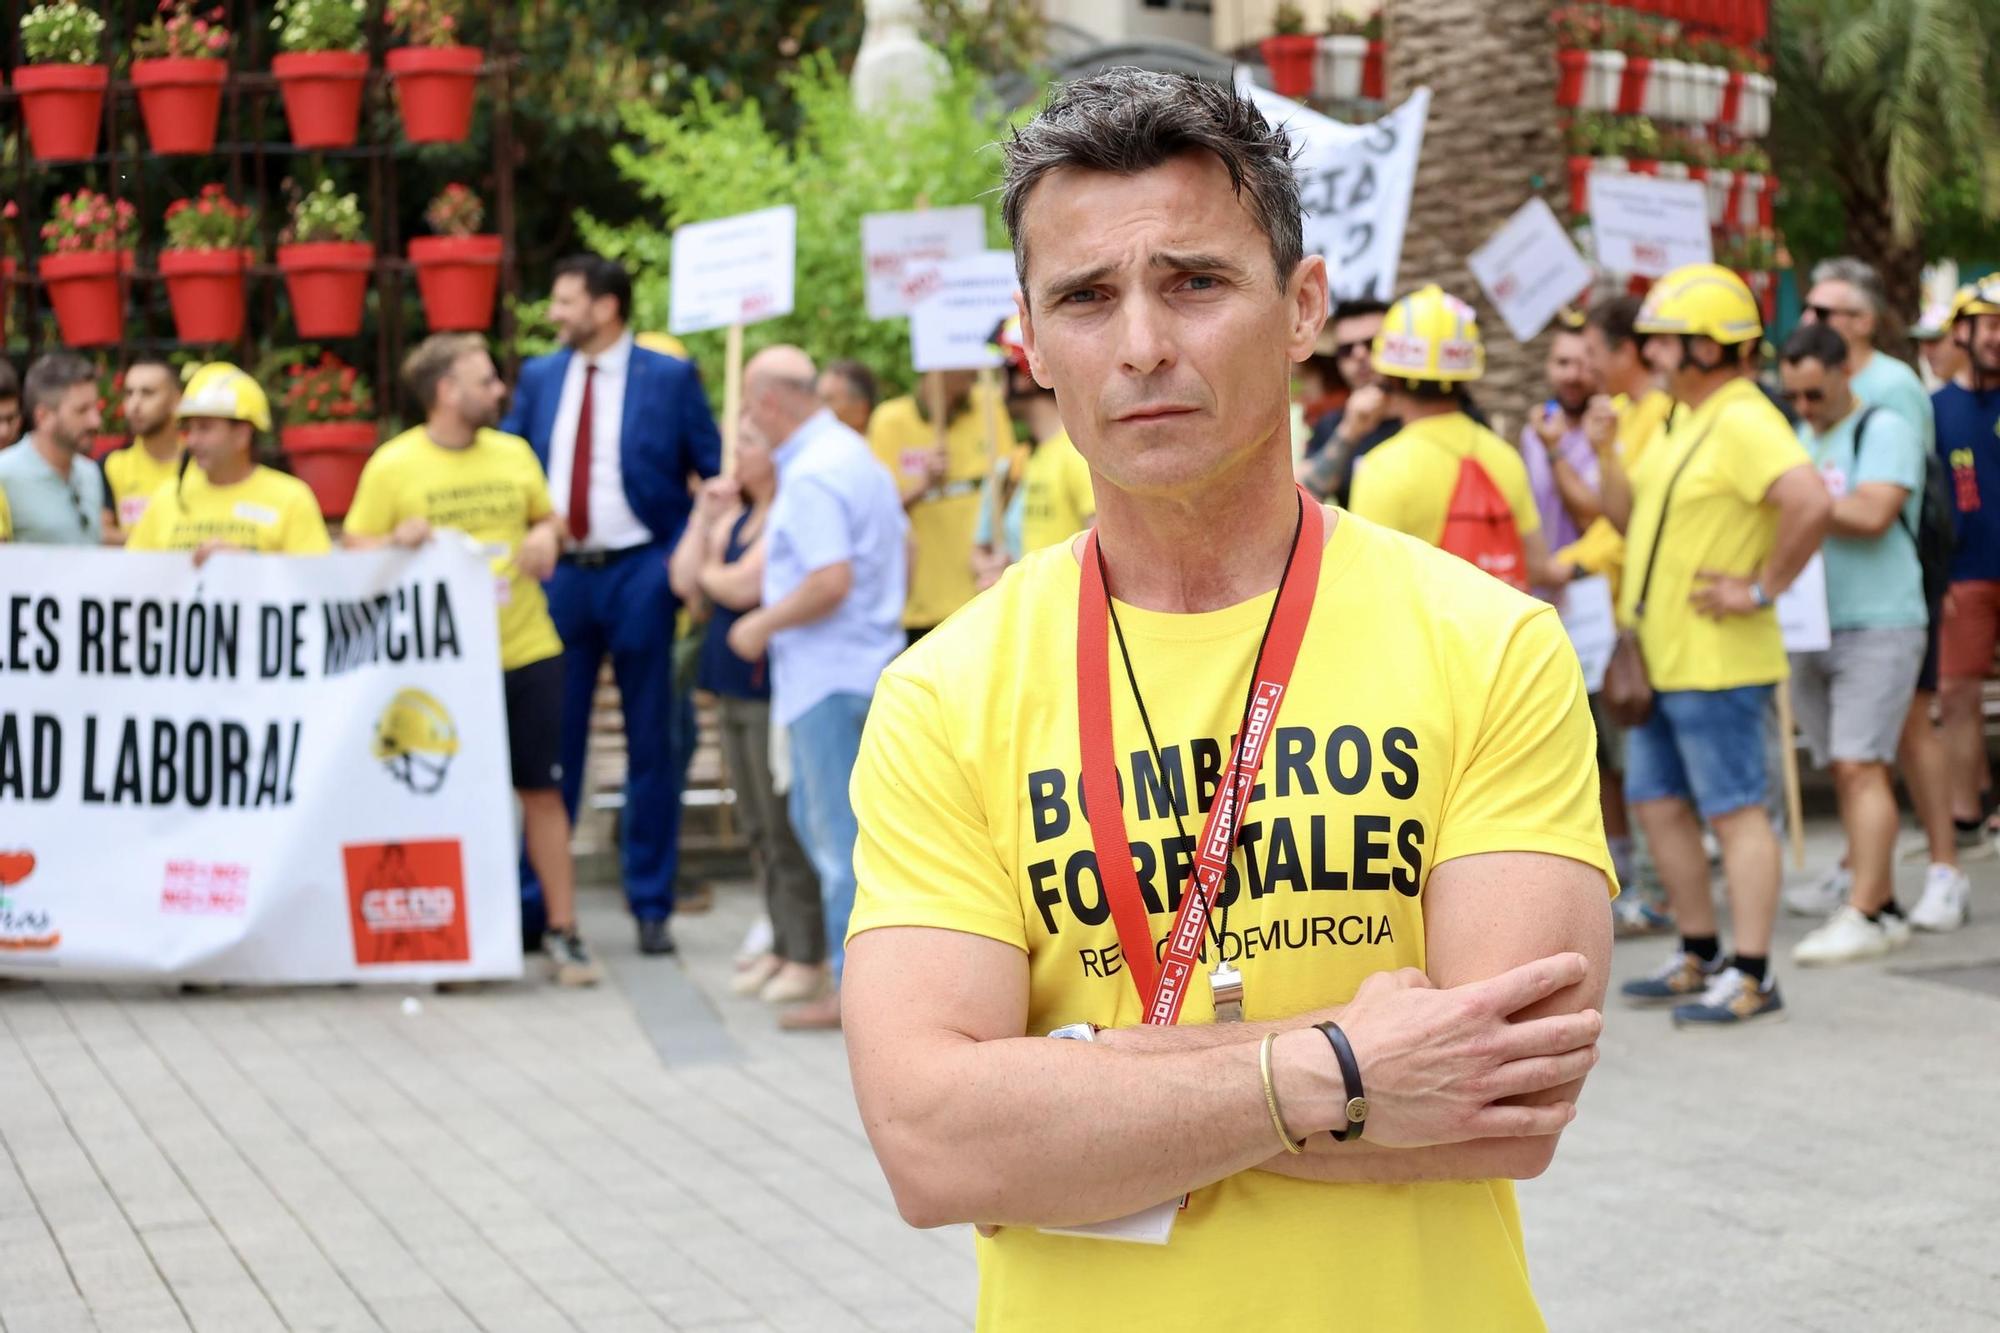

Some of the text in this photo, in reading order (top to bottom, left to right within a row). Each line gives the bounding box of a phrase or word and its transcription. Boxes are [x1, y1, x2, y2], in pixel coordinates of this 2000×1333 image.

[0, 596, 60, 673] ES
[80, 581, 239, 678] REGIÓN
[260, 603, 307, 678] DE
[1257, 914, 1395, 952] MURCIA
